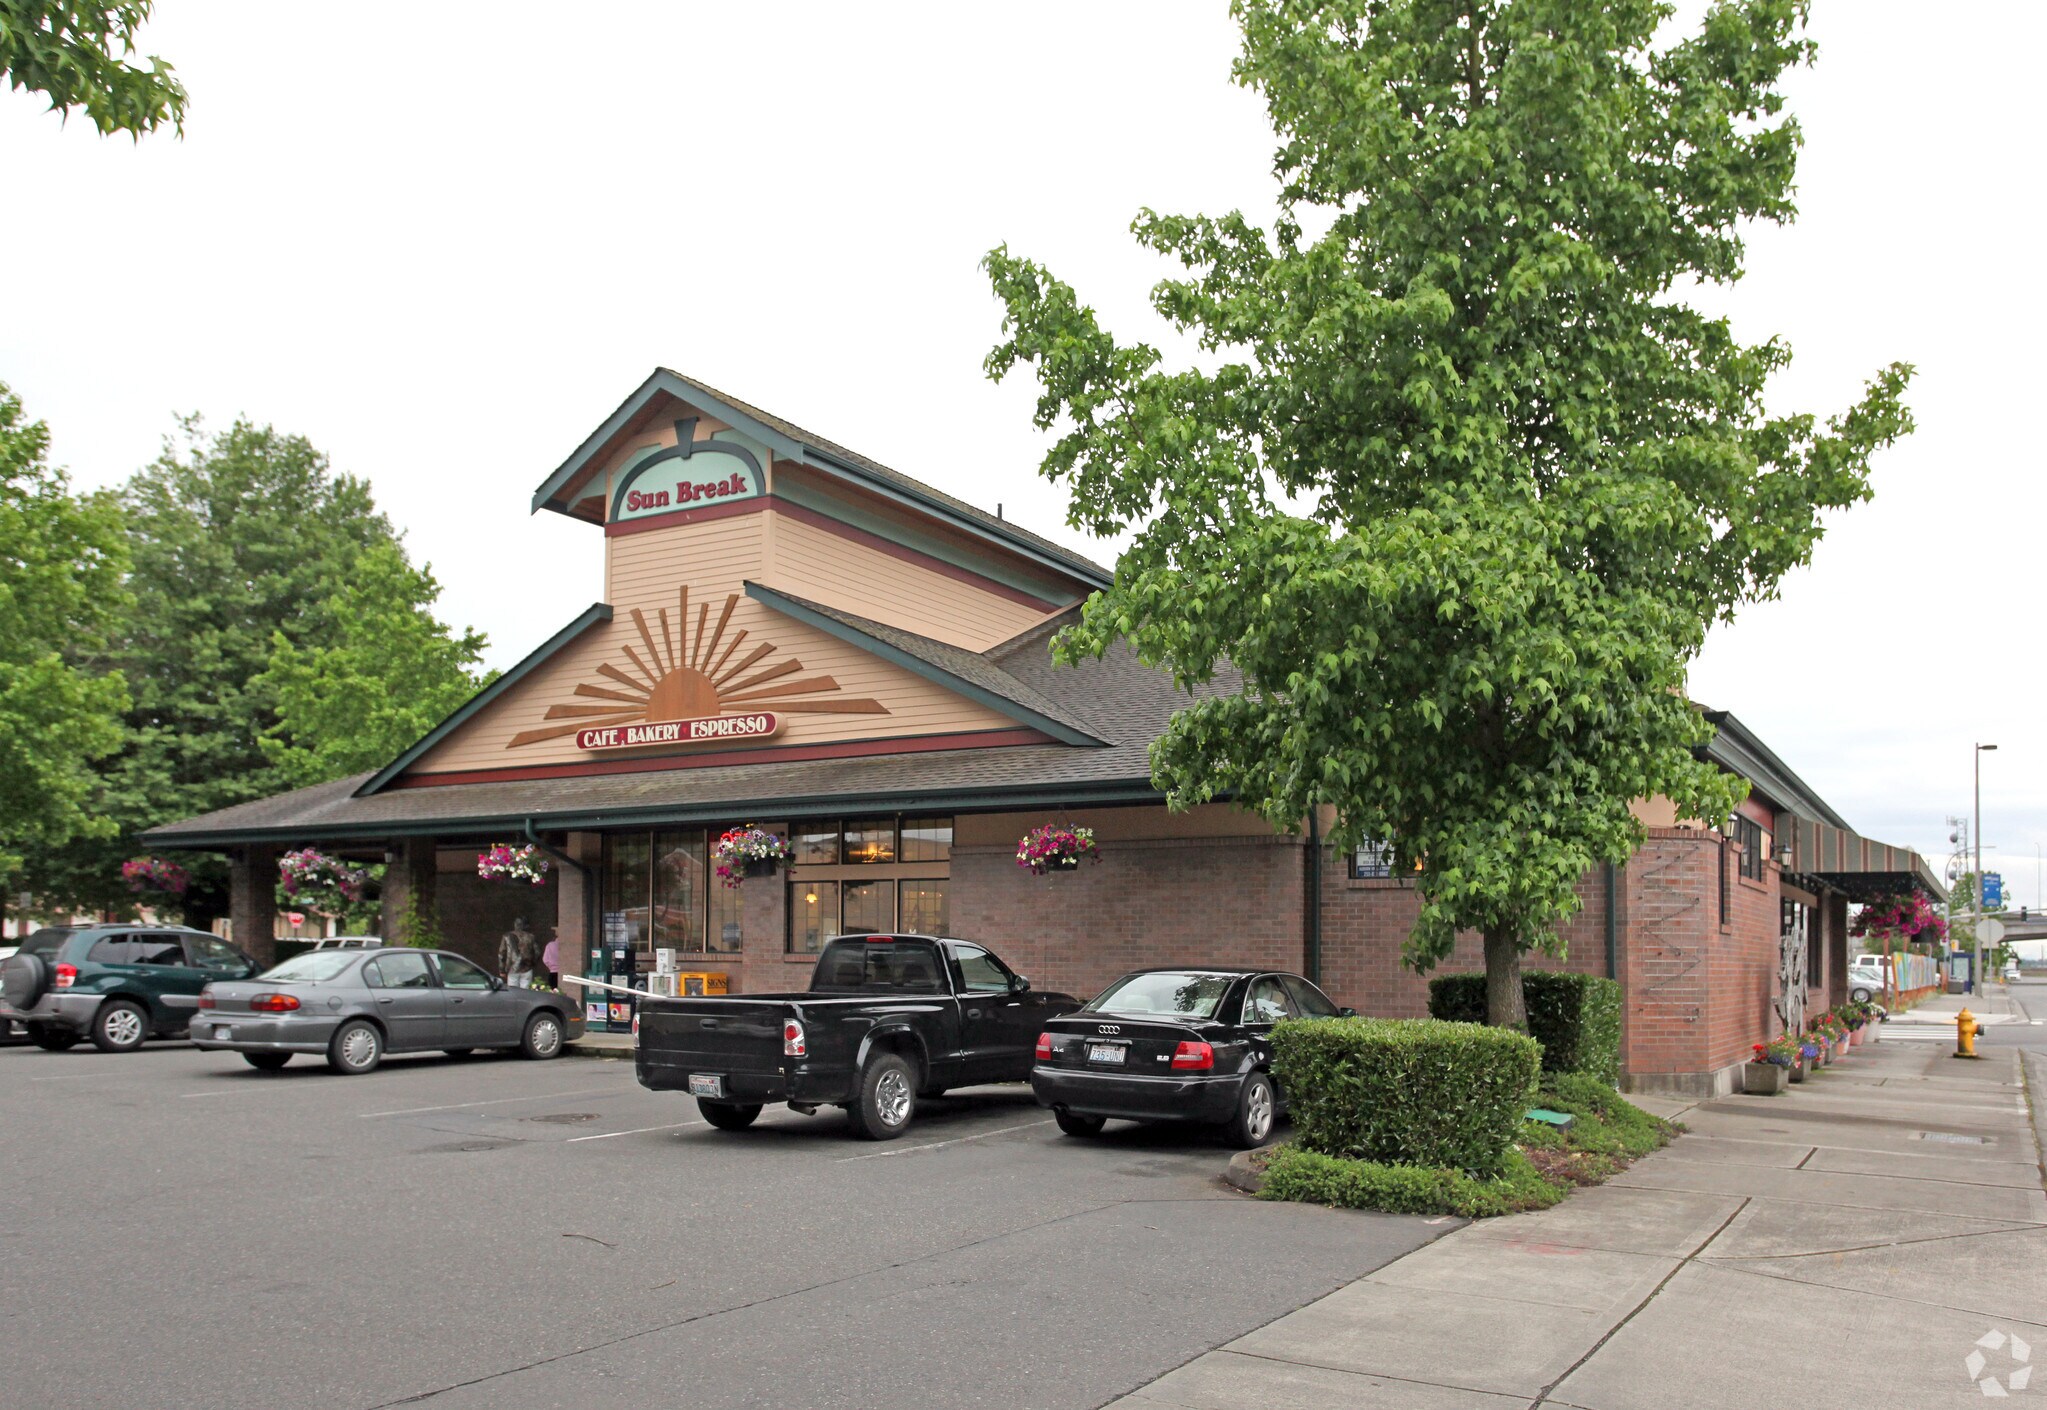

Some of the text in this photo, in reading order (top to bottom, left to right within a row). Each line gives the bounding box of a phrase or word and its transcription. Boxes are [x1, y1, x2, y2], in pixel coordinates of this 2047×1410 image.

[627, 472, 747, 511] Sun Break
[583, 715, 767, 747] CAFE BAKERY ESPRESSO
